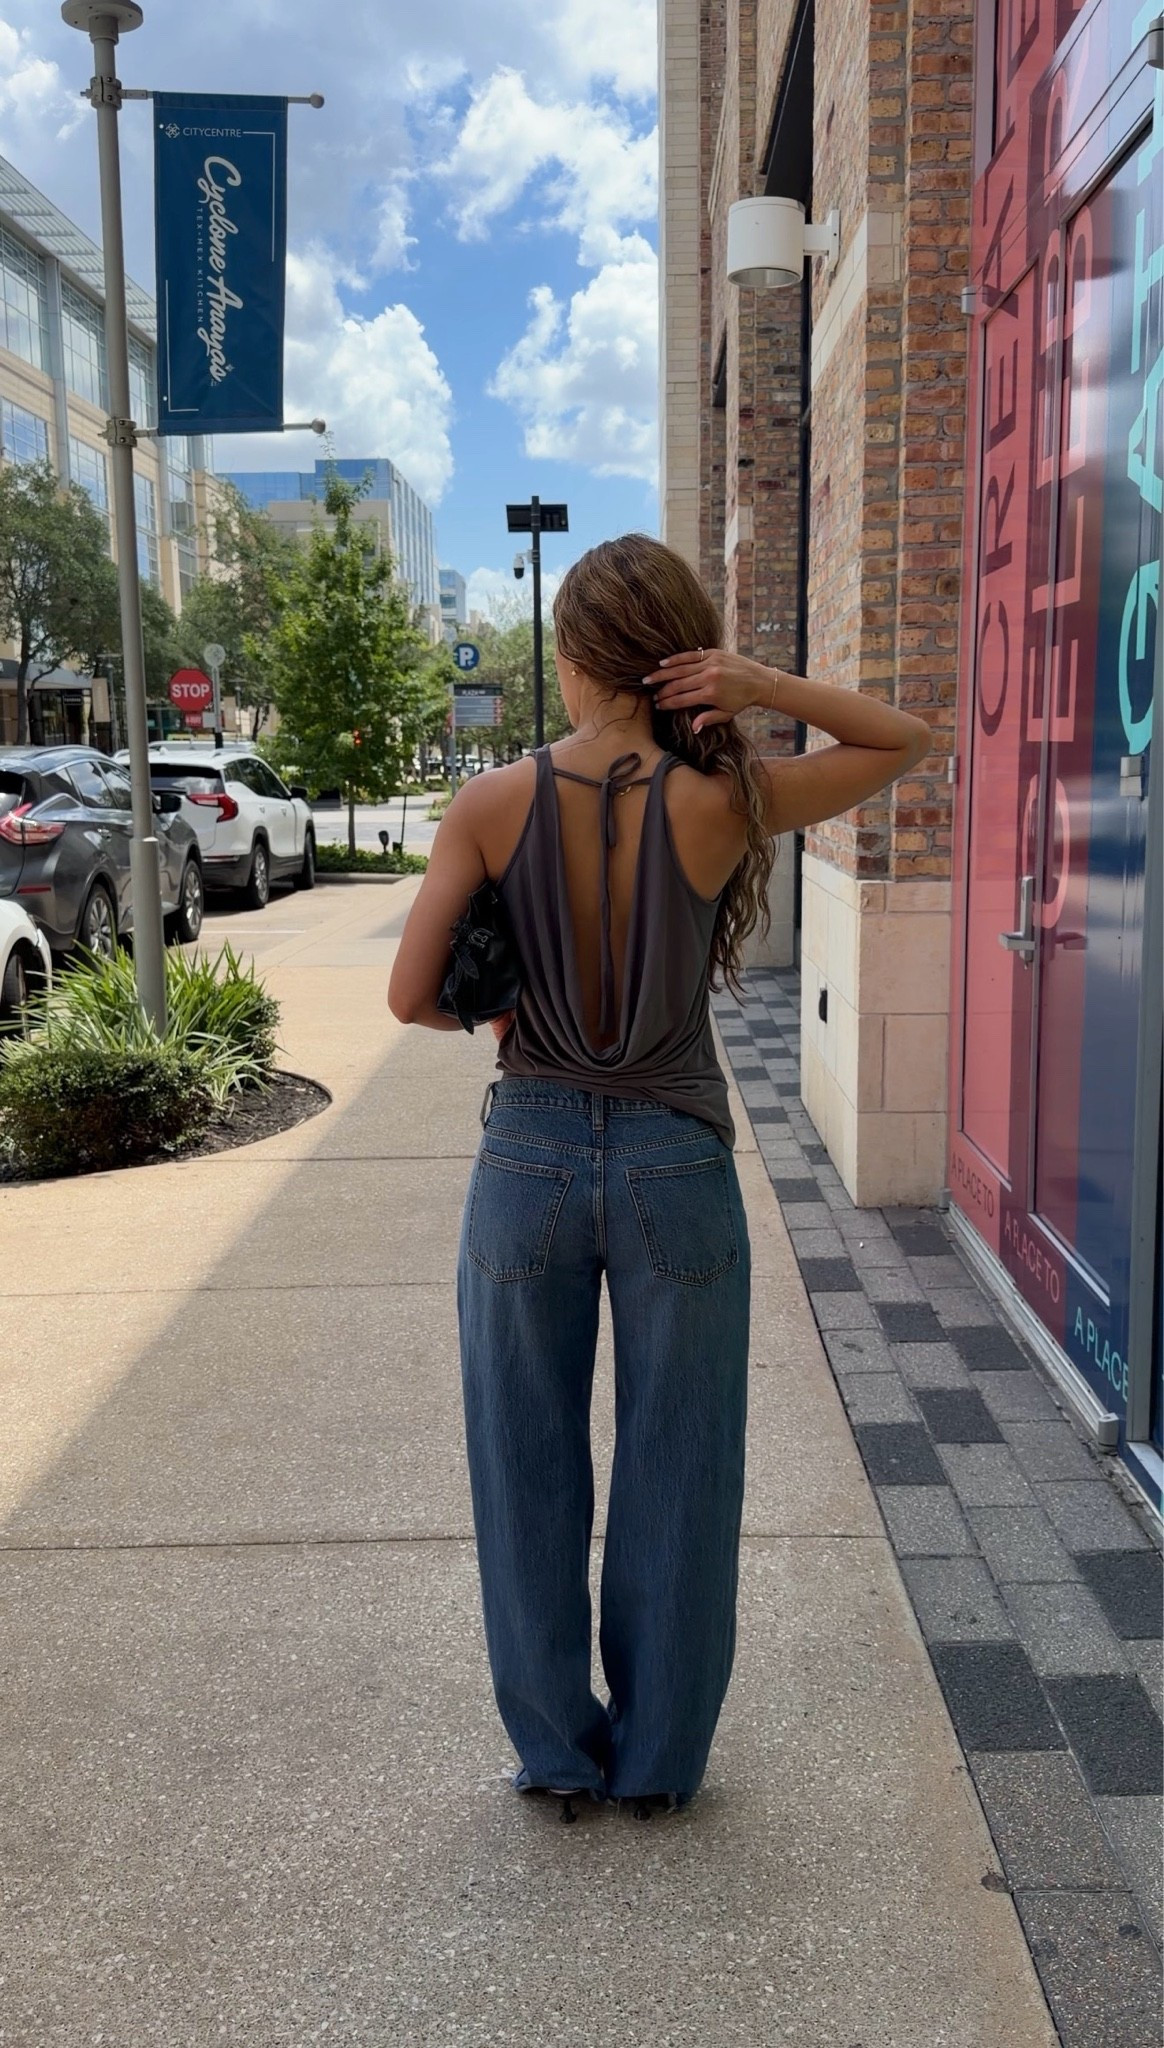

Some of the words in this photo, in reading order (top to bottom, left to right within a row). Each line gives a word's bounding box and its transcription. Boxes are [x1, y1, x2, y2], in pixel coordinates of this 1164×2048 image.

[183, 127, 242, 138] CITYCENTRE
[197, 156, 242, 273] Cyclone
[459, 647, 475, 667] P
[171, 684, 210, 698] STOP
[951, 1151, 957, 1179] A
[958, 1157, 982, 1206] PLACE
[983, 1183, 994, 1218] TO
[1004, 1210, 1012, 1241] A
[1013, 1218, 1042, 1282] PLACE
[1044, 1257, 1060, 1304] TO
[1074, 1306, 1085, 1346] A
[1086, 1317, 1129, 1403] PLACE
